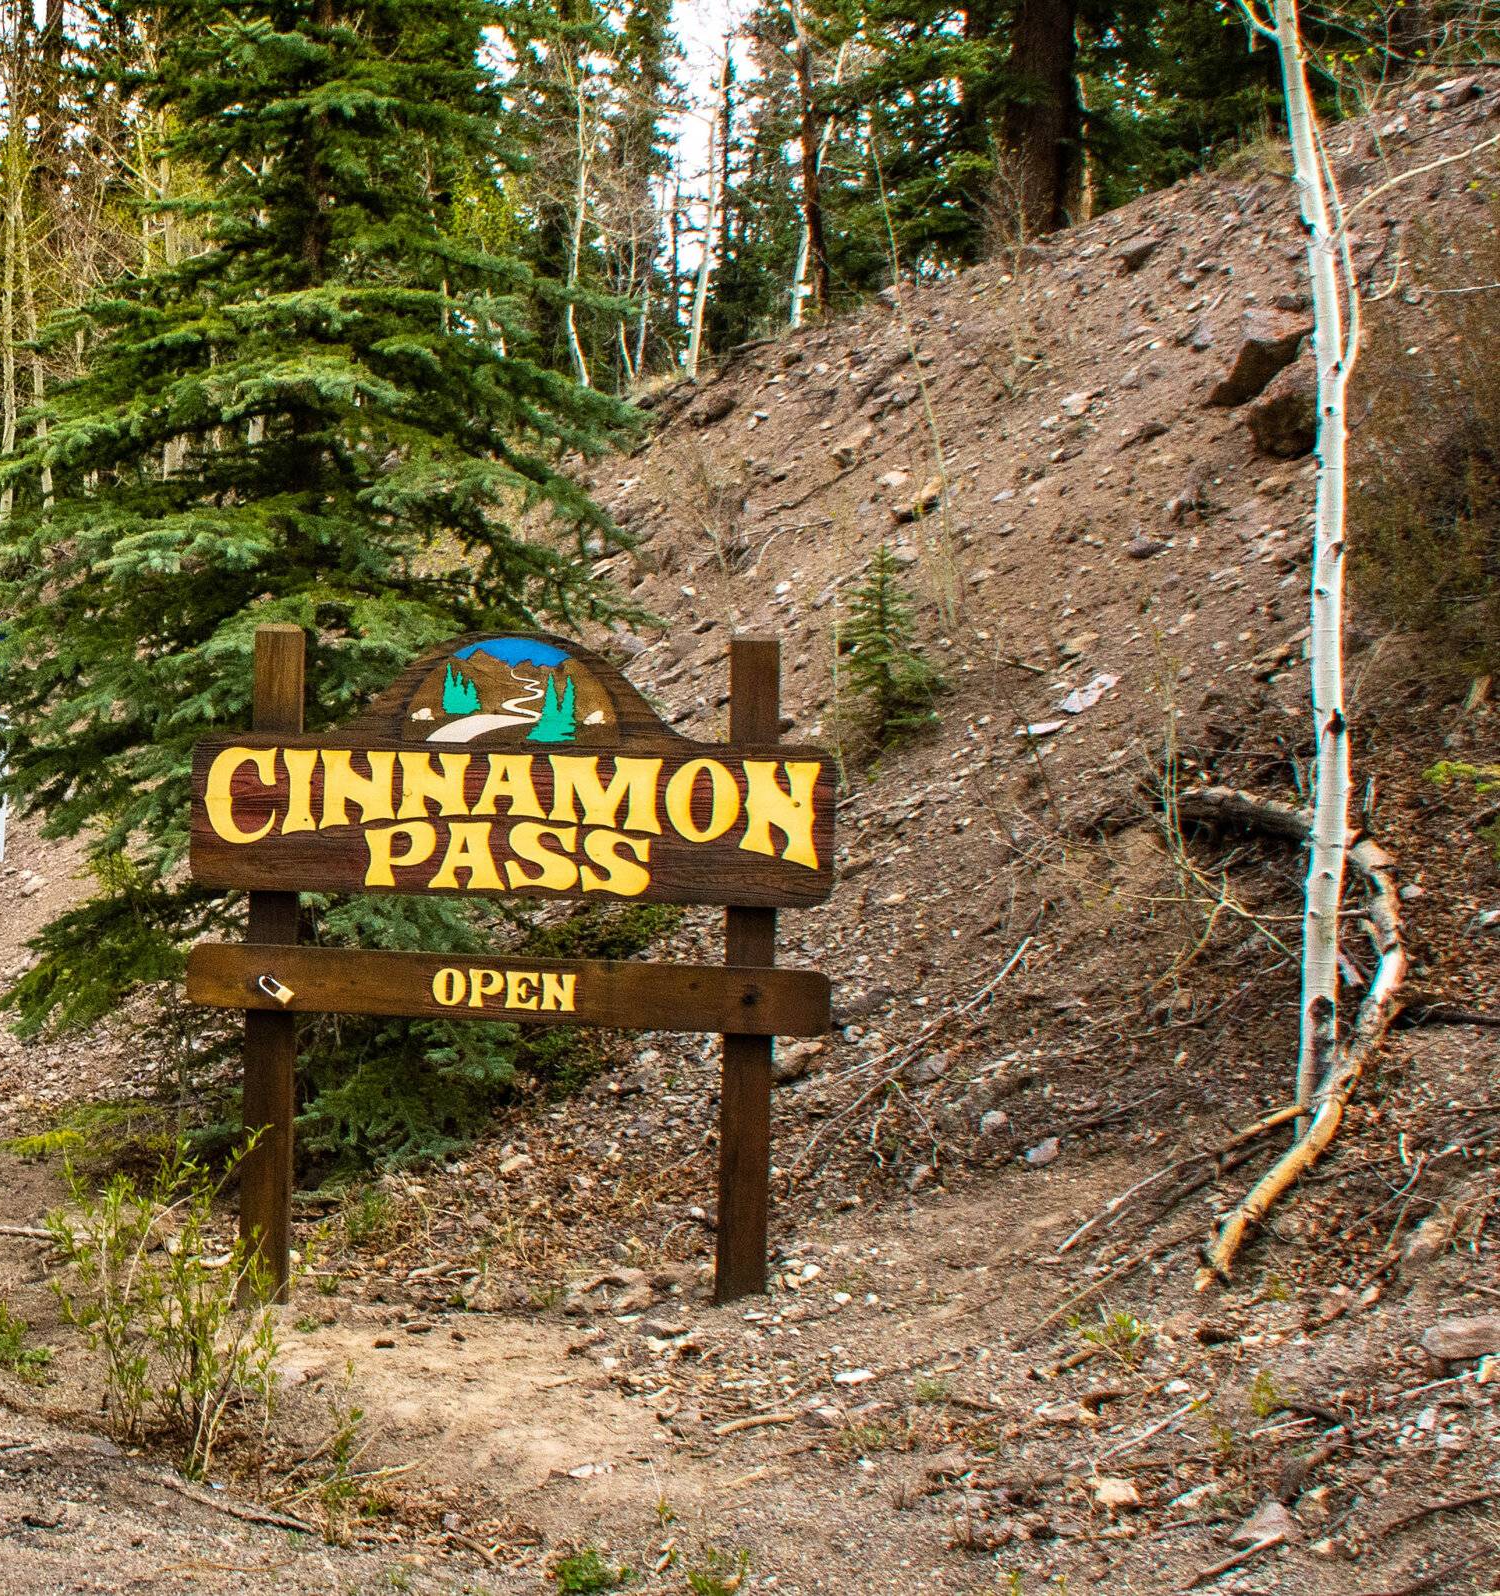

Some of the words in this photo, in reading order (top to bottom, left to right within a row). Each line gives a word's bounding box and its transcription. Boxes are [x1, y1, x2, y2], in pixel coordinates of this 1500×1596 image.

[204, 746, 821, 870] CINNAMON
[364, 821, 651, 896] PASS
[432, 968, 577, 1012] OPEN
